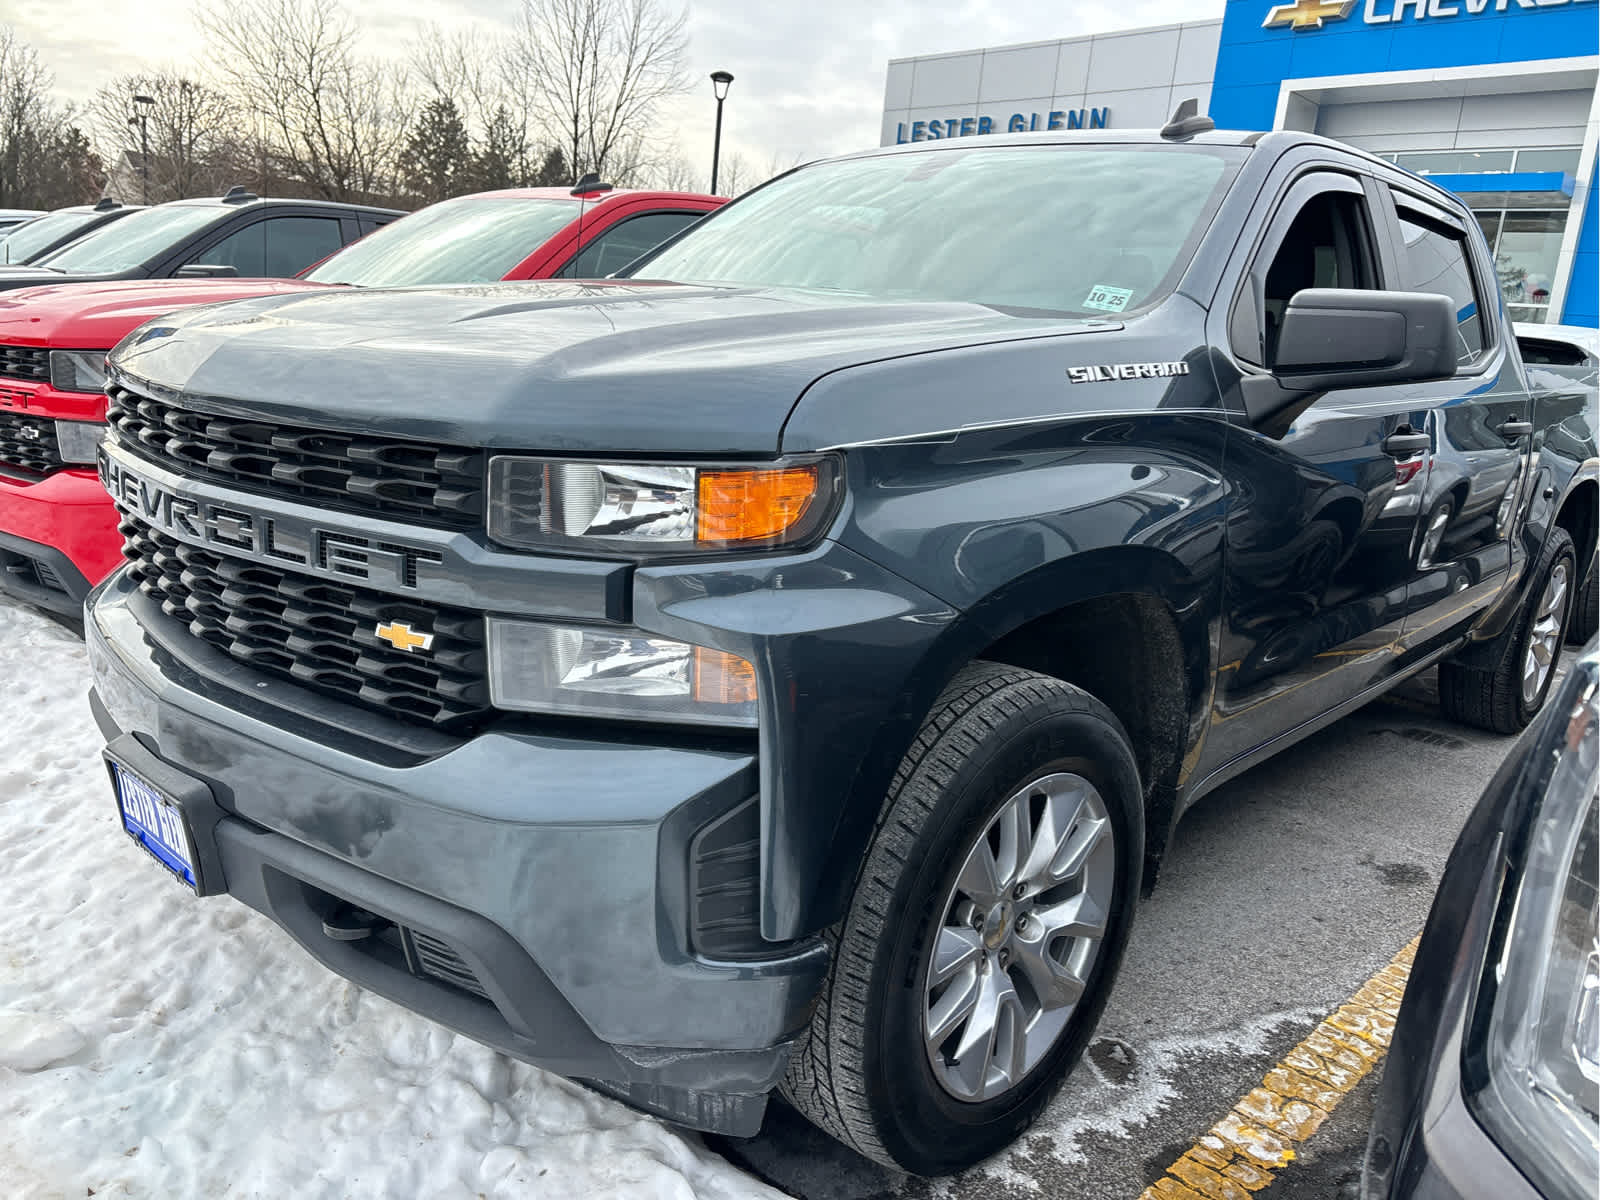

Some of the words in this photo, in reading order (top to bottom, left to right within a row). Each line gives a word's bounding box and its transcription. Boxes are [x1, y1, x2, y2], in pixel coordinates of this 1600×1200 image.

[897, 116, 993, 145] LESTER
[1089, 292, 1106, 302] 10
[1108, 295, 1126, 306] 25
[1066, 361, 1190, 384] SILVERADO
